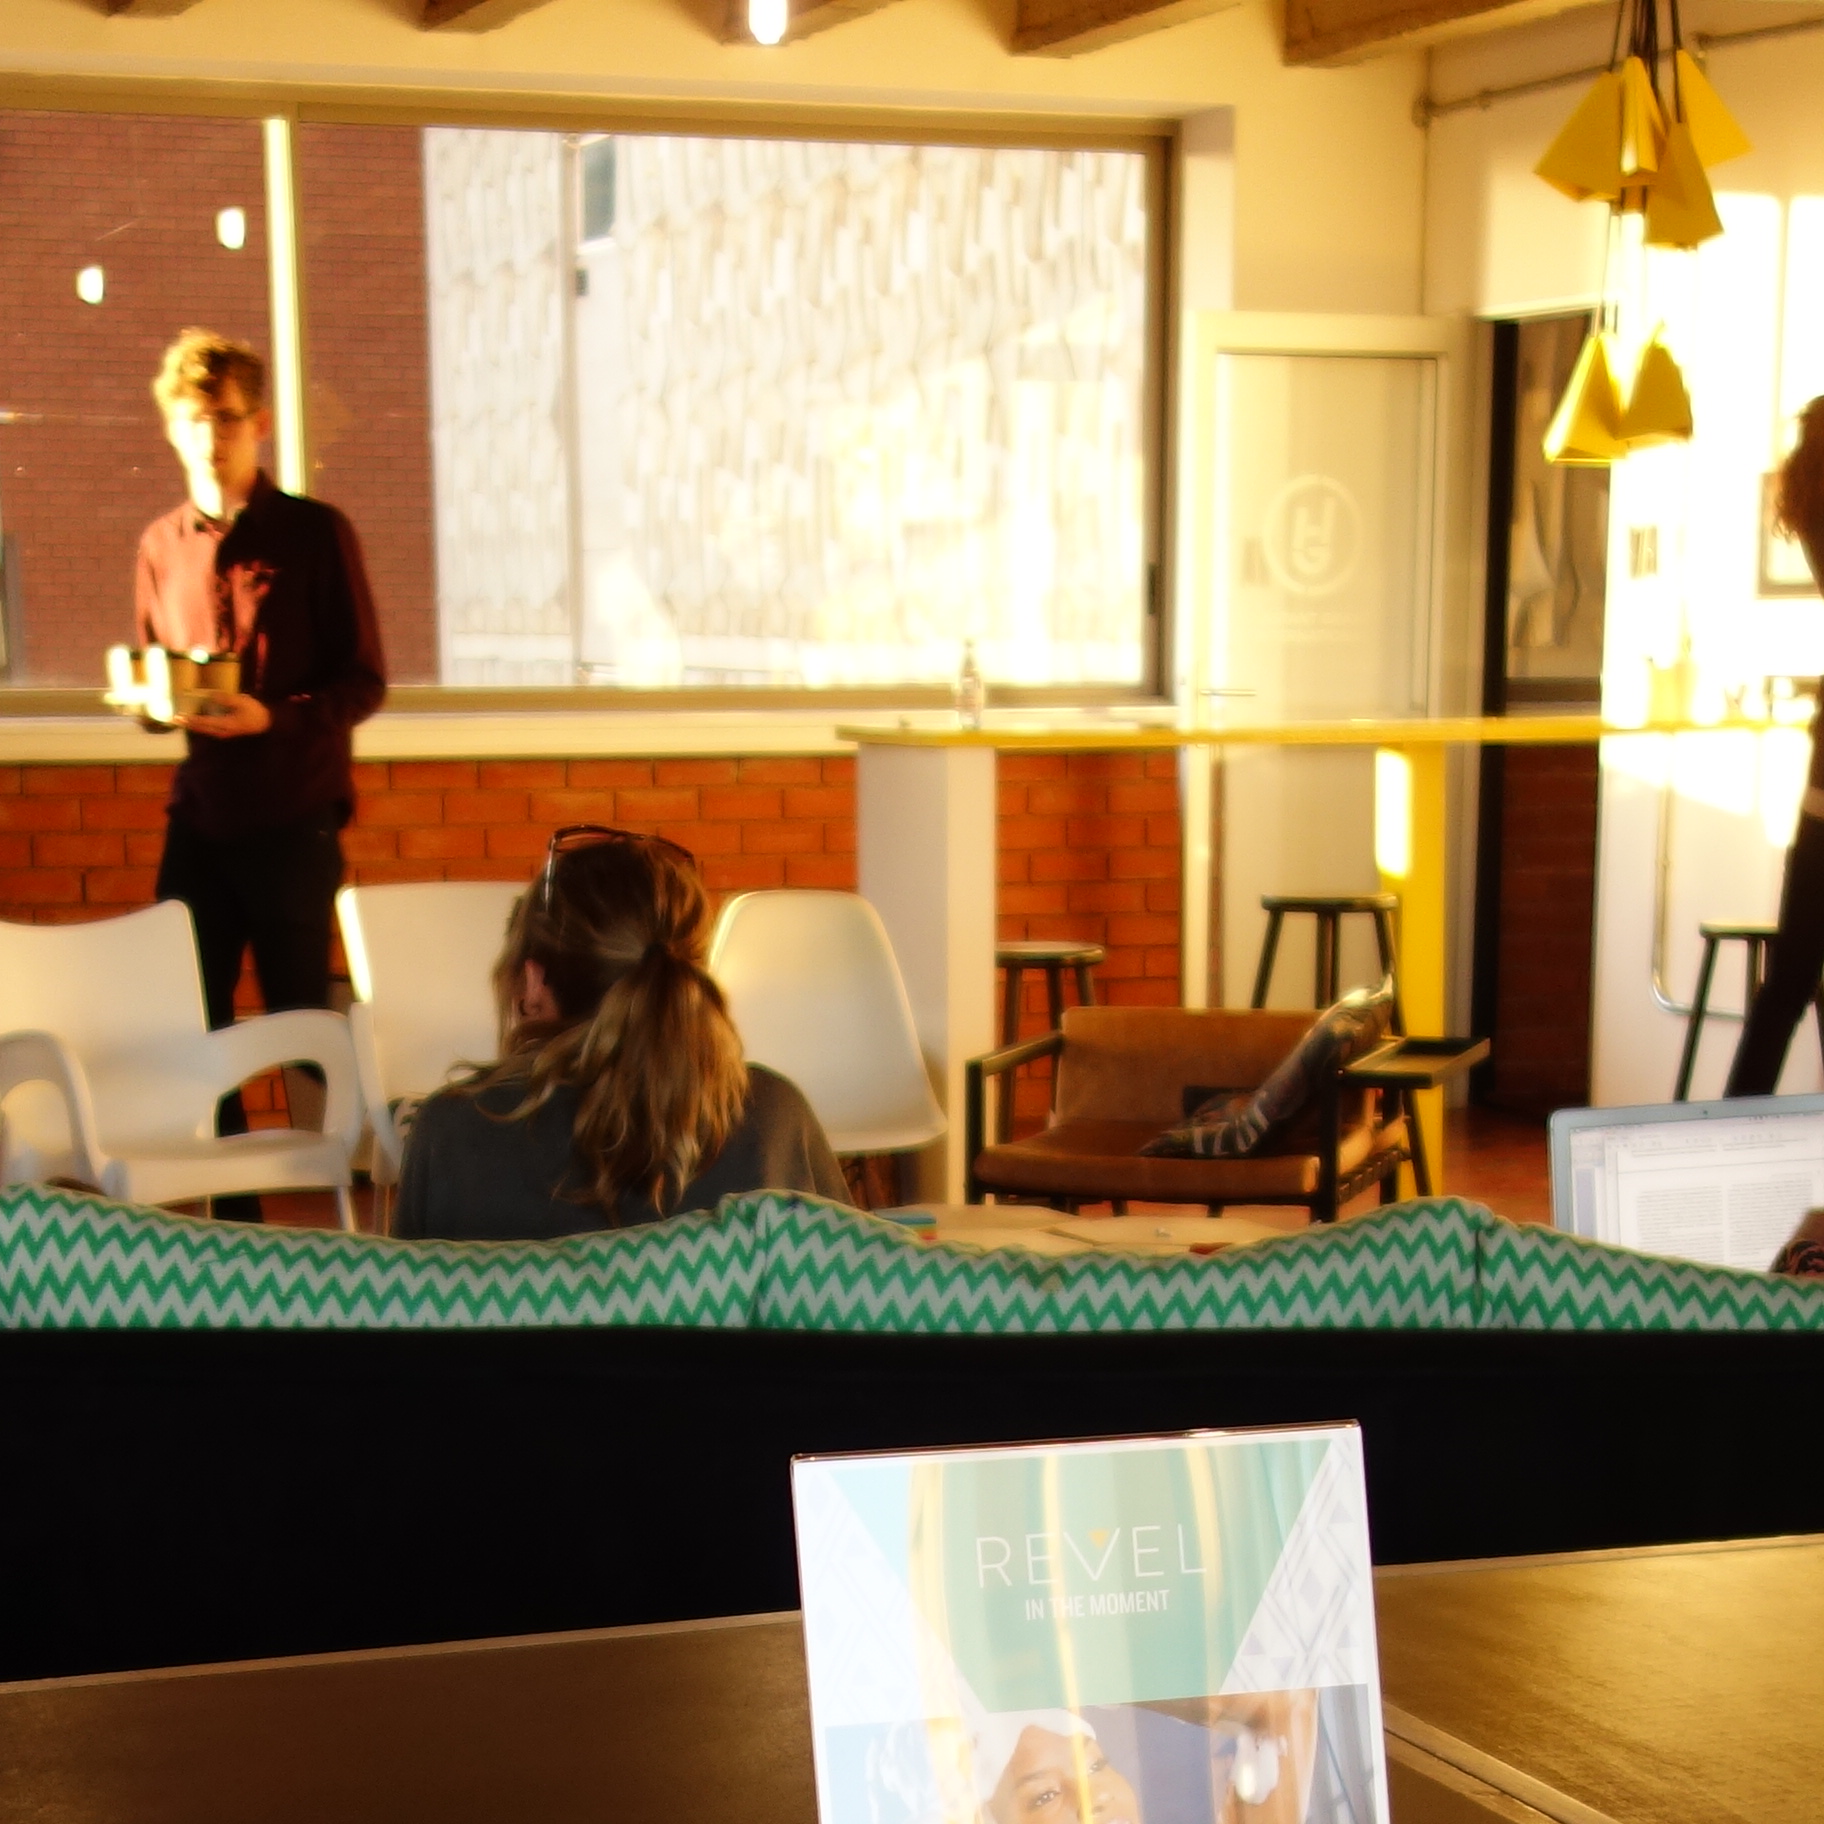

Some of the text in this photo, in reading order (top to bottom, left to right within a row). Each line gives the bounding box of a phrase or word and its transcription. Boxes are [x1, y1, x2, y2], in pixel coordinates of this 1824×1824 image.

[976, 1523, 1207, 1589] REVEL
[1026, 1589, 1170, 1620] IN THE MOMENT
